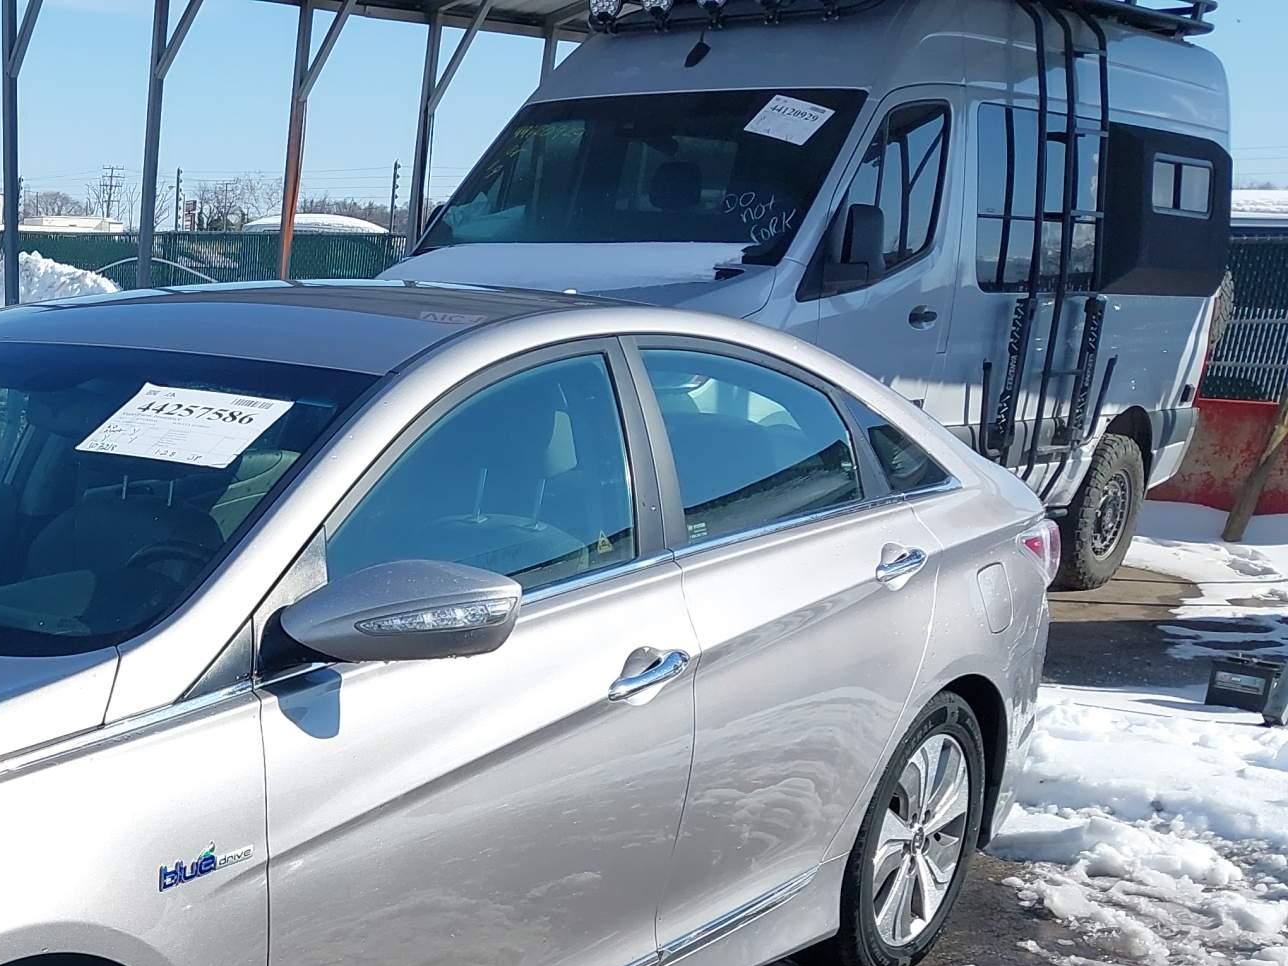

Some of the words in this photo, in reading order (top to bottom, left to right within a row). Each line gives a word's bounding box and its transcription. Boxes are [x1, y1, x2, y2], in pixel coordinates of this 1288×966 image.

[769, 104, 820, 122] 44120929
[722, 191, 756, 214] DO
[136, 400, 257, 425] 44257586
[158, 848, 217, 892] blue
[218, 847, 252, 866] drive
